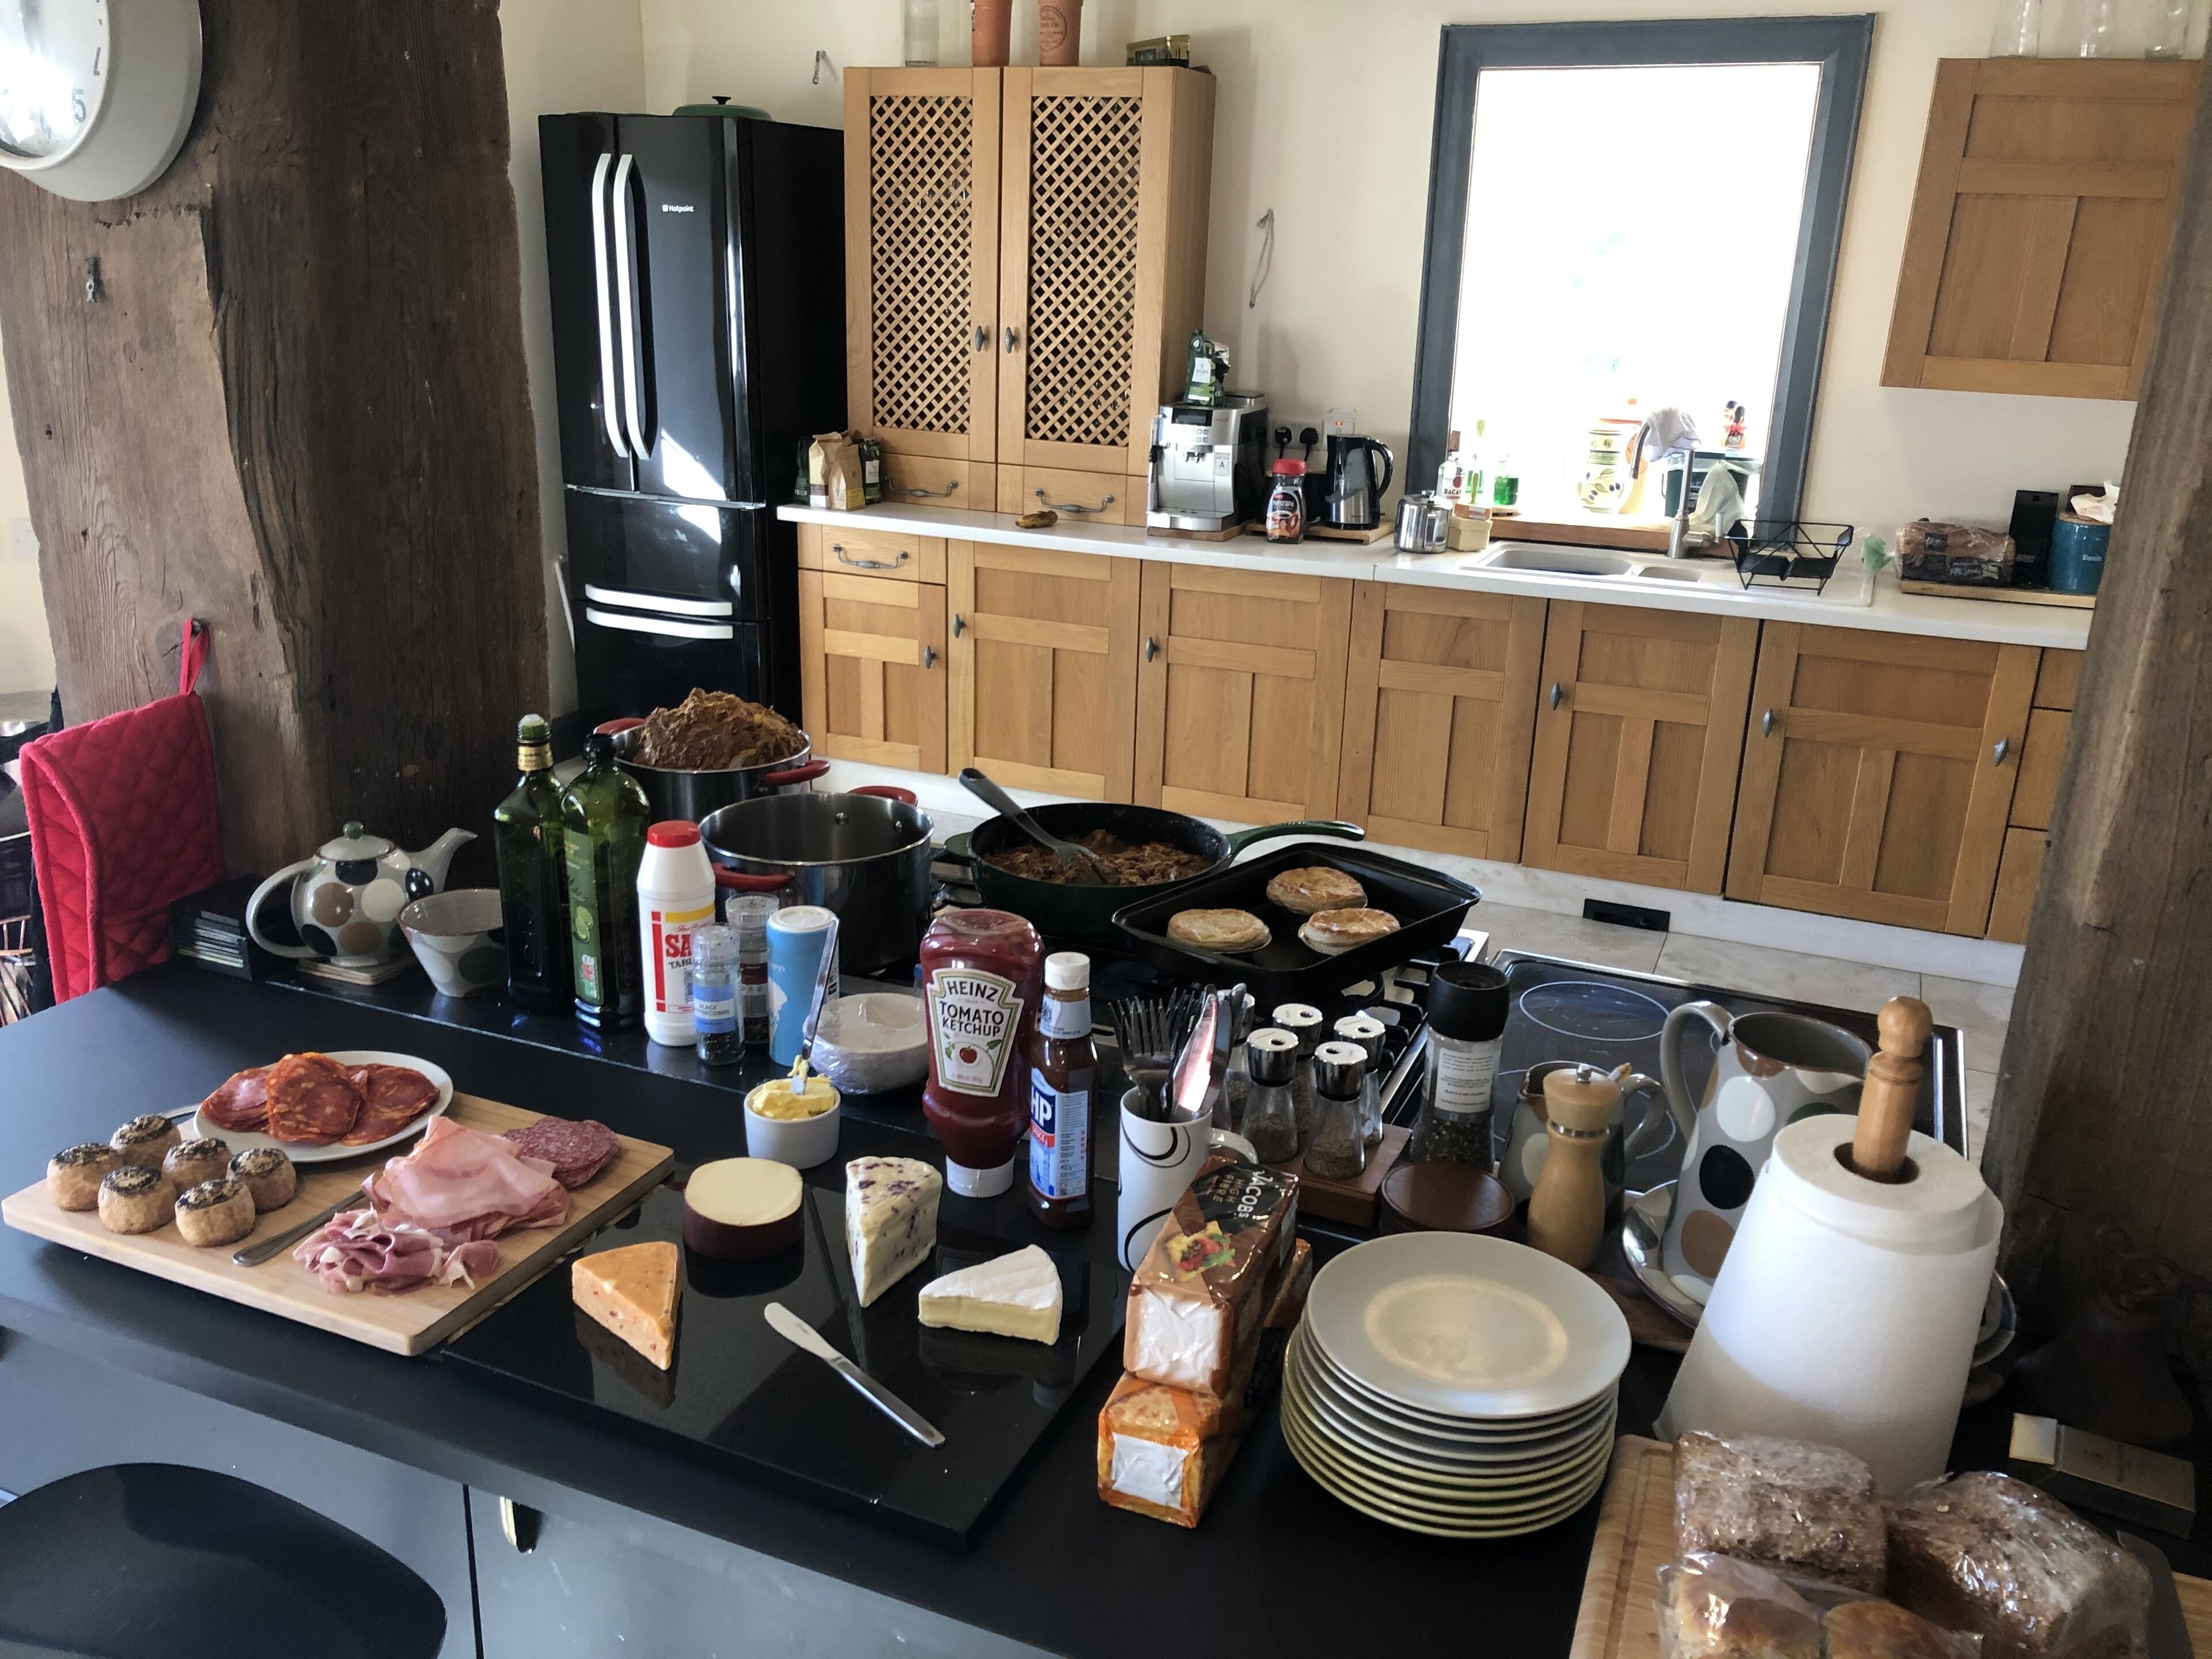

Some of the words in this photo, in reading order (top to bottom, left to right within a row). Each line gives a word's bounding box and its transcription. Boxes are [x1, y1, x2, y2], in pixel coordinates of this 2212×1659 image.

[72, 88, 86, 123] 5
[669, 205, 694, 213] Hotpoint
[665, 933, 692, 958] SA
[669, 958, 692, 969] TABL
[947, 980, 999, 1002] HEINZ
[939, 1001, 1005, 1025] TOMATO
[942, 1017, 1001, 1037] KETCHUP
[1031, 1084, 1052, 1127] HP
[1213, 1174, 1234, 1203] FIBRE
[1226, 1179, 1245, 1203] HIGH
